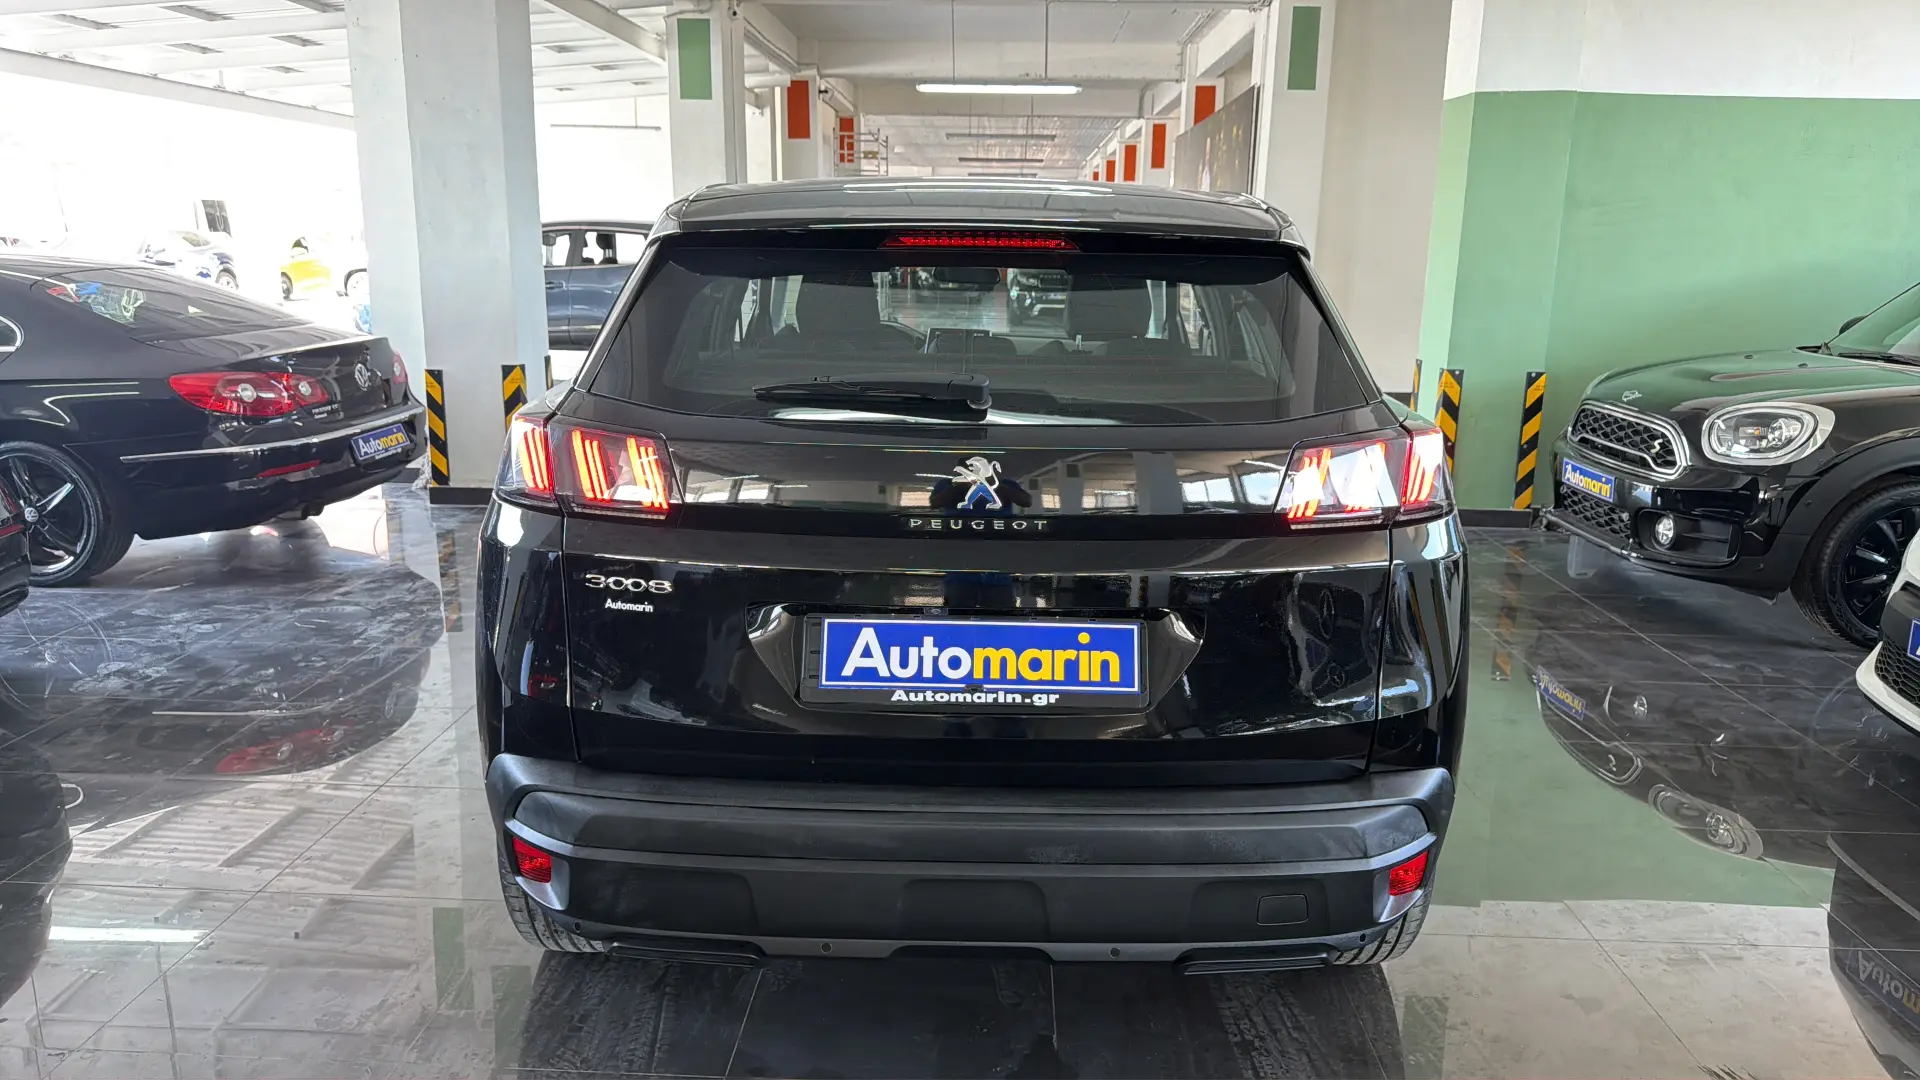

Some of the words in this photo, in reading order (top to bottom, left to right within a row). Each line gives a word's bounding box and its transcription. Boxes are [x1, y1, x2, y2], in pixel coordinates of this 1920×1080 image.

[358, 427, 406, 456] Automarin
[1565, 463, 1611, 498] Automarin
[910, 518, 1047, 530] PEUGEOT
[585, 573, 673, 594] 3008
[605, 598, 654, 613] Automarin
[841, 627, 1120, 682] Automarin
[890, 689, 1060, 706] Automarin.gr
